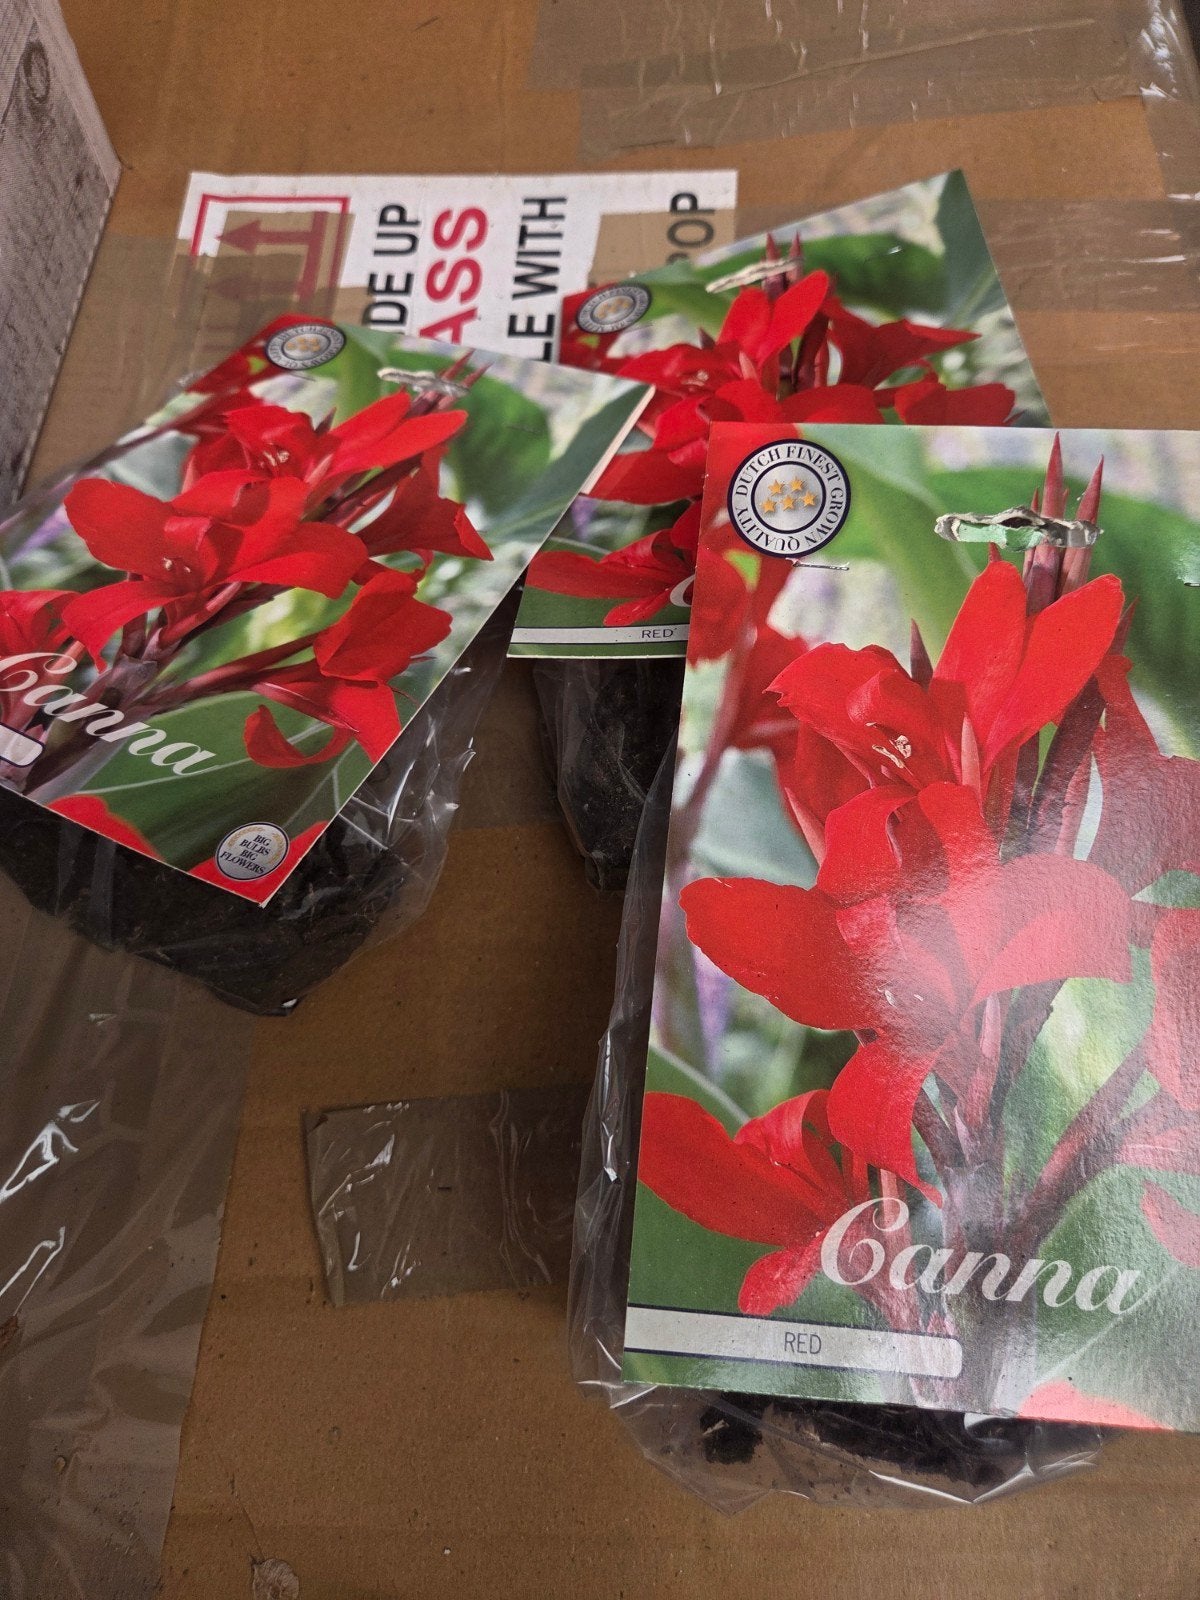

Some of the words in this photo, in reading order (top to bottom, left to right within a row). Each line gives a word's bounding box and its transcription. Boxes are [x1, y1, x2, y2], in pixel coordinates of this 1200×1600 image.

[373, 204, 421, 258] UP
[511, 197, 567, 300] WITH
[666, 192, 716, 264] OP
[361, 272, 414, 334] DE
[735, 447, 781, 496] DUTCH
[786, 445, 841, 482] FINEST
[735, 507, 800, 551] QUALITY
[804, 487, 844, 546] GROWN
[641, 628, 674, 639] RED
[0, 652, 217, 776] Canna
[220, 851, 265, 874] FLOWERS
[239, 838, 271, 856] BULBS
[240, 849, 257, 861] BIG
[253, 834, 271, 847] BIG
[820, 1197, 1158, 1315] Canna
[784, 1331, 822, 1354] RED
